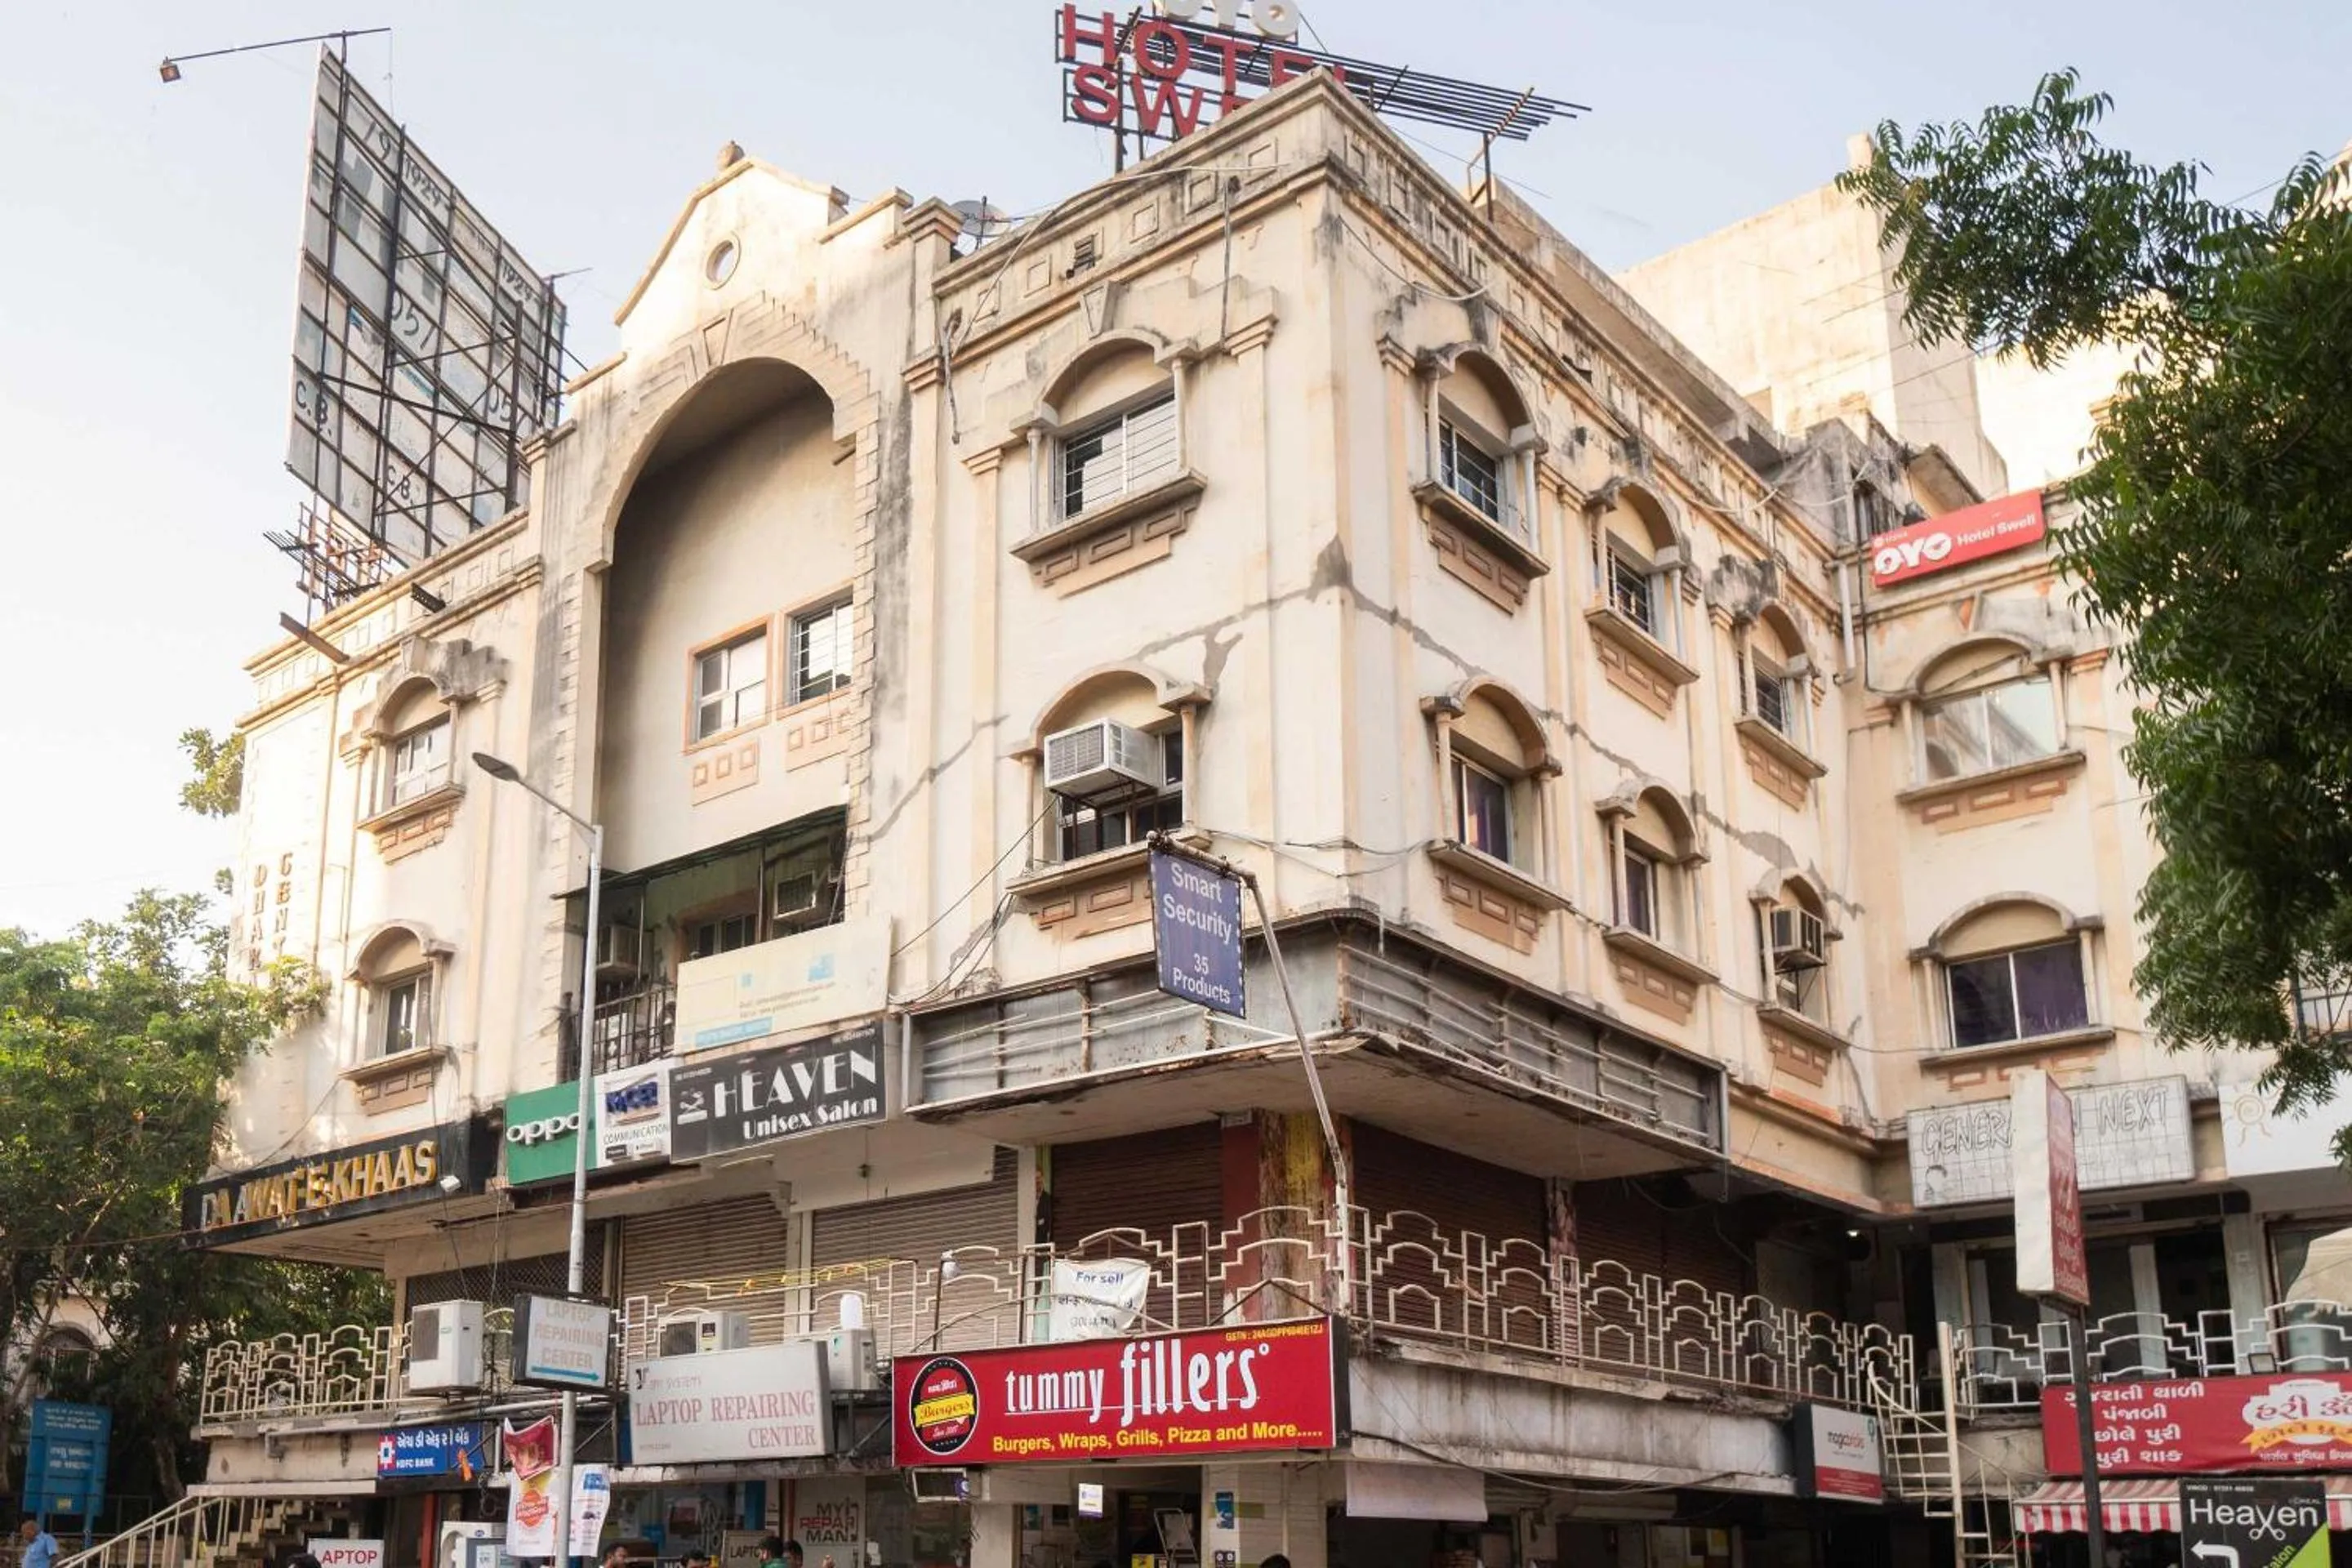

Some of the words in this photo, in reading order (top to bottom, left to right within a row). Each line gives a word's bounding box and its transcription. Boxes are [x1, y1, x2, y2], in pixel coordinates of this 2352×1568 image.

[1957, 528, 1995, 547] Hotel
[1998, 514, 2036, 536] Swell
[1874, 532, 1952, 574] OYO
[1171, 862, 1223, 903] Smart
[1164, 893, 1232, 945] Security
[1194, 953, 1209, 975] 35
[1173, 967, 1231, 1004] Products
[714, 1049, 876, 1118] HEAVEN
[743, 1112, 812, 1140] Unisex
[817, 1097, 878, 1125] Salon
[2098, 1085, 2169, 1137] NEXT
[635, 1397, 702, 1427] LAPTOP
[710, 1390, 816, 1422] REPAIRING
[1005, 1369, 1105, 1423] tummy
[748, 1425, 817, 1449] CENTER
[993, 1436, 1055, 1454] Burgers,
[1058, 1432, 1111, 1450] Wraps,
[1116, 1429, 1163, 1447] Grills,
[1168, 1426, 1211, 1444] Pizza
[1215, 1424, 1248, 1441] and
[2145, 1423, 2181, 1446] પુરી
[396, 1459, 413, 1468] HDFC
[415, 1457, 435, 1468] BANK
[817, 1502, 844, 1517] MY
[2189, 1498, 2319, 1540] Heaven
[730, 1545, 760, 1558] LAPTO
[805, 1529, 849, 1544] MAN
[321, 1549, 378, 1566] APTOP
[2267, 1544, 2297, 1568] alon
